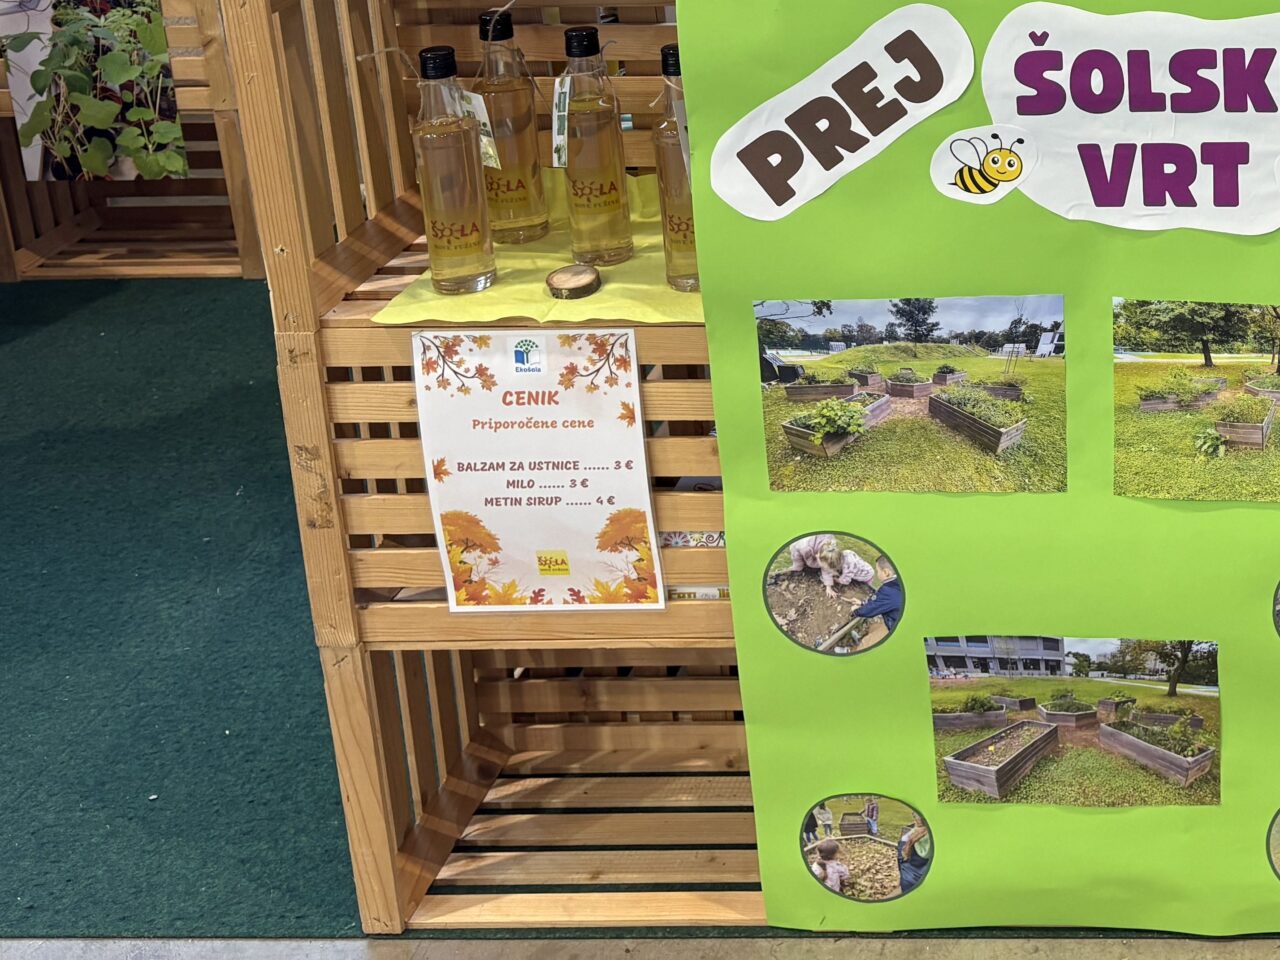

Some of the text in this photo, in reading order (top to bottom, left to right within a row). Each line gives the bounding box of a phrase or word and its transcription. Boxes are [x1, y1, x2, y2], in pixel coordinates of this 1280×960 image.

[736, 29, 945, 207] PREJ
[1077, 141, 1251, 208] VRT
[572, 178, 618, 203] ŠOLA
[431, 219, 480, 244] ŠOLA
[502, 390, 559, 406] CENIK
[472, 417, 595, 433] Priporočene cene
[457, 462, 505, 472] BALZAM
[509, 461, 525, 471] ZA
[528, 460, 580, 471] USTNICE
[614, 461, 622, 470] 3
[625, 460, 634, 470] €
[506, 479, 535, 489] MILO
[569, 479, 577, 488] 3
[580, 478, 589, 488] €
[484, 496, 522, 506] METIN
[526, 496, 562, 506] SIRUP
[596, 496, 604, 505] 4
[606, 496, 615, 505] €
